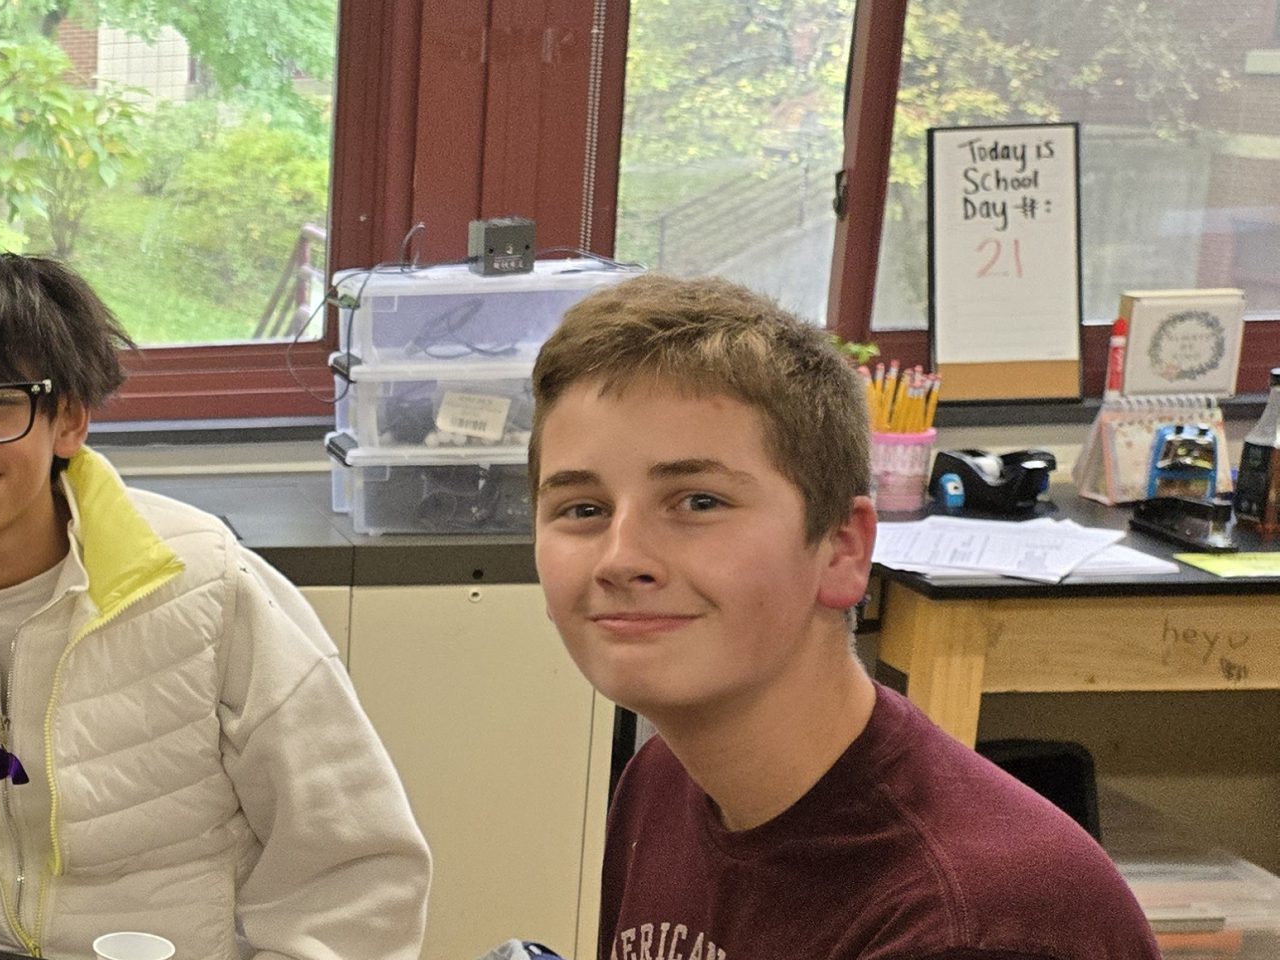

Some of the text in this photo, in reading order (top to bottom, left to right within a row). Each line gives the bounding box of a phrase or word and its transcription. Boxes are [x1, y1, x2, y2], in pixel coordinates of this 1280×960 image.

[958, 137, 1055, 173] Today is
[963, 167, 1039, 195] School
[963, 196, 1008, 232] Day
[975, 238, 1024, 279] 21
